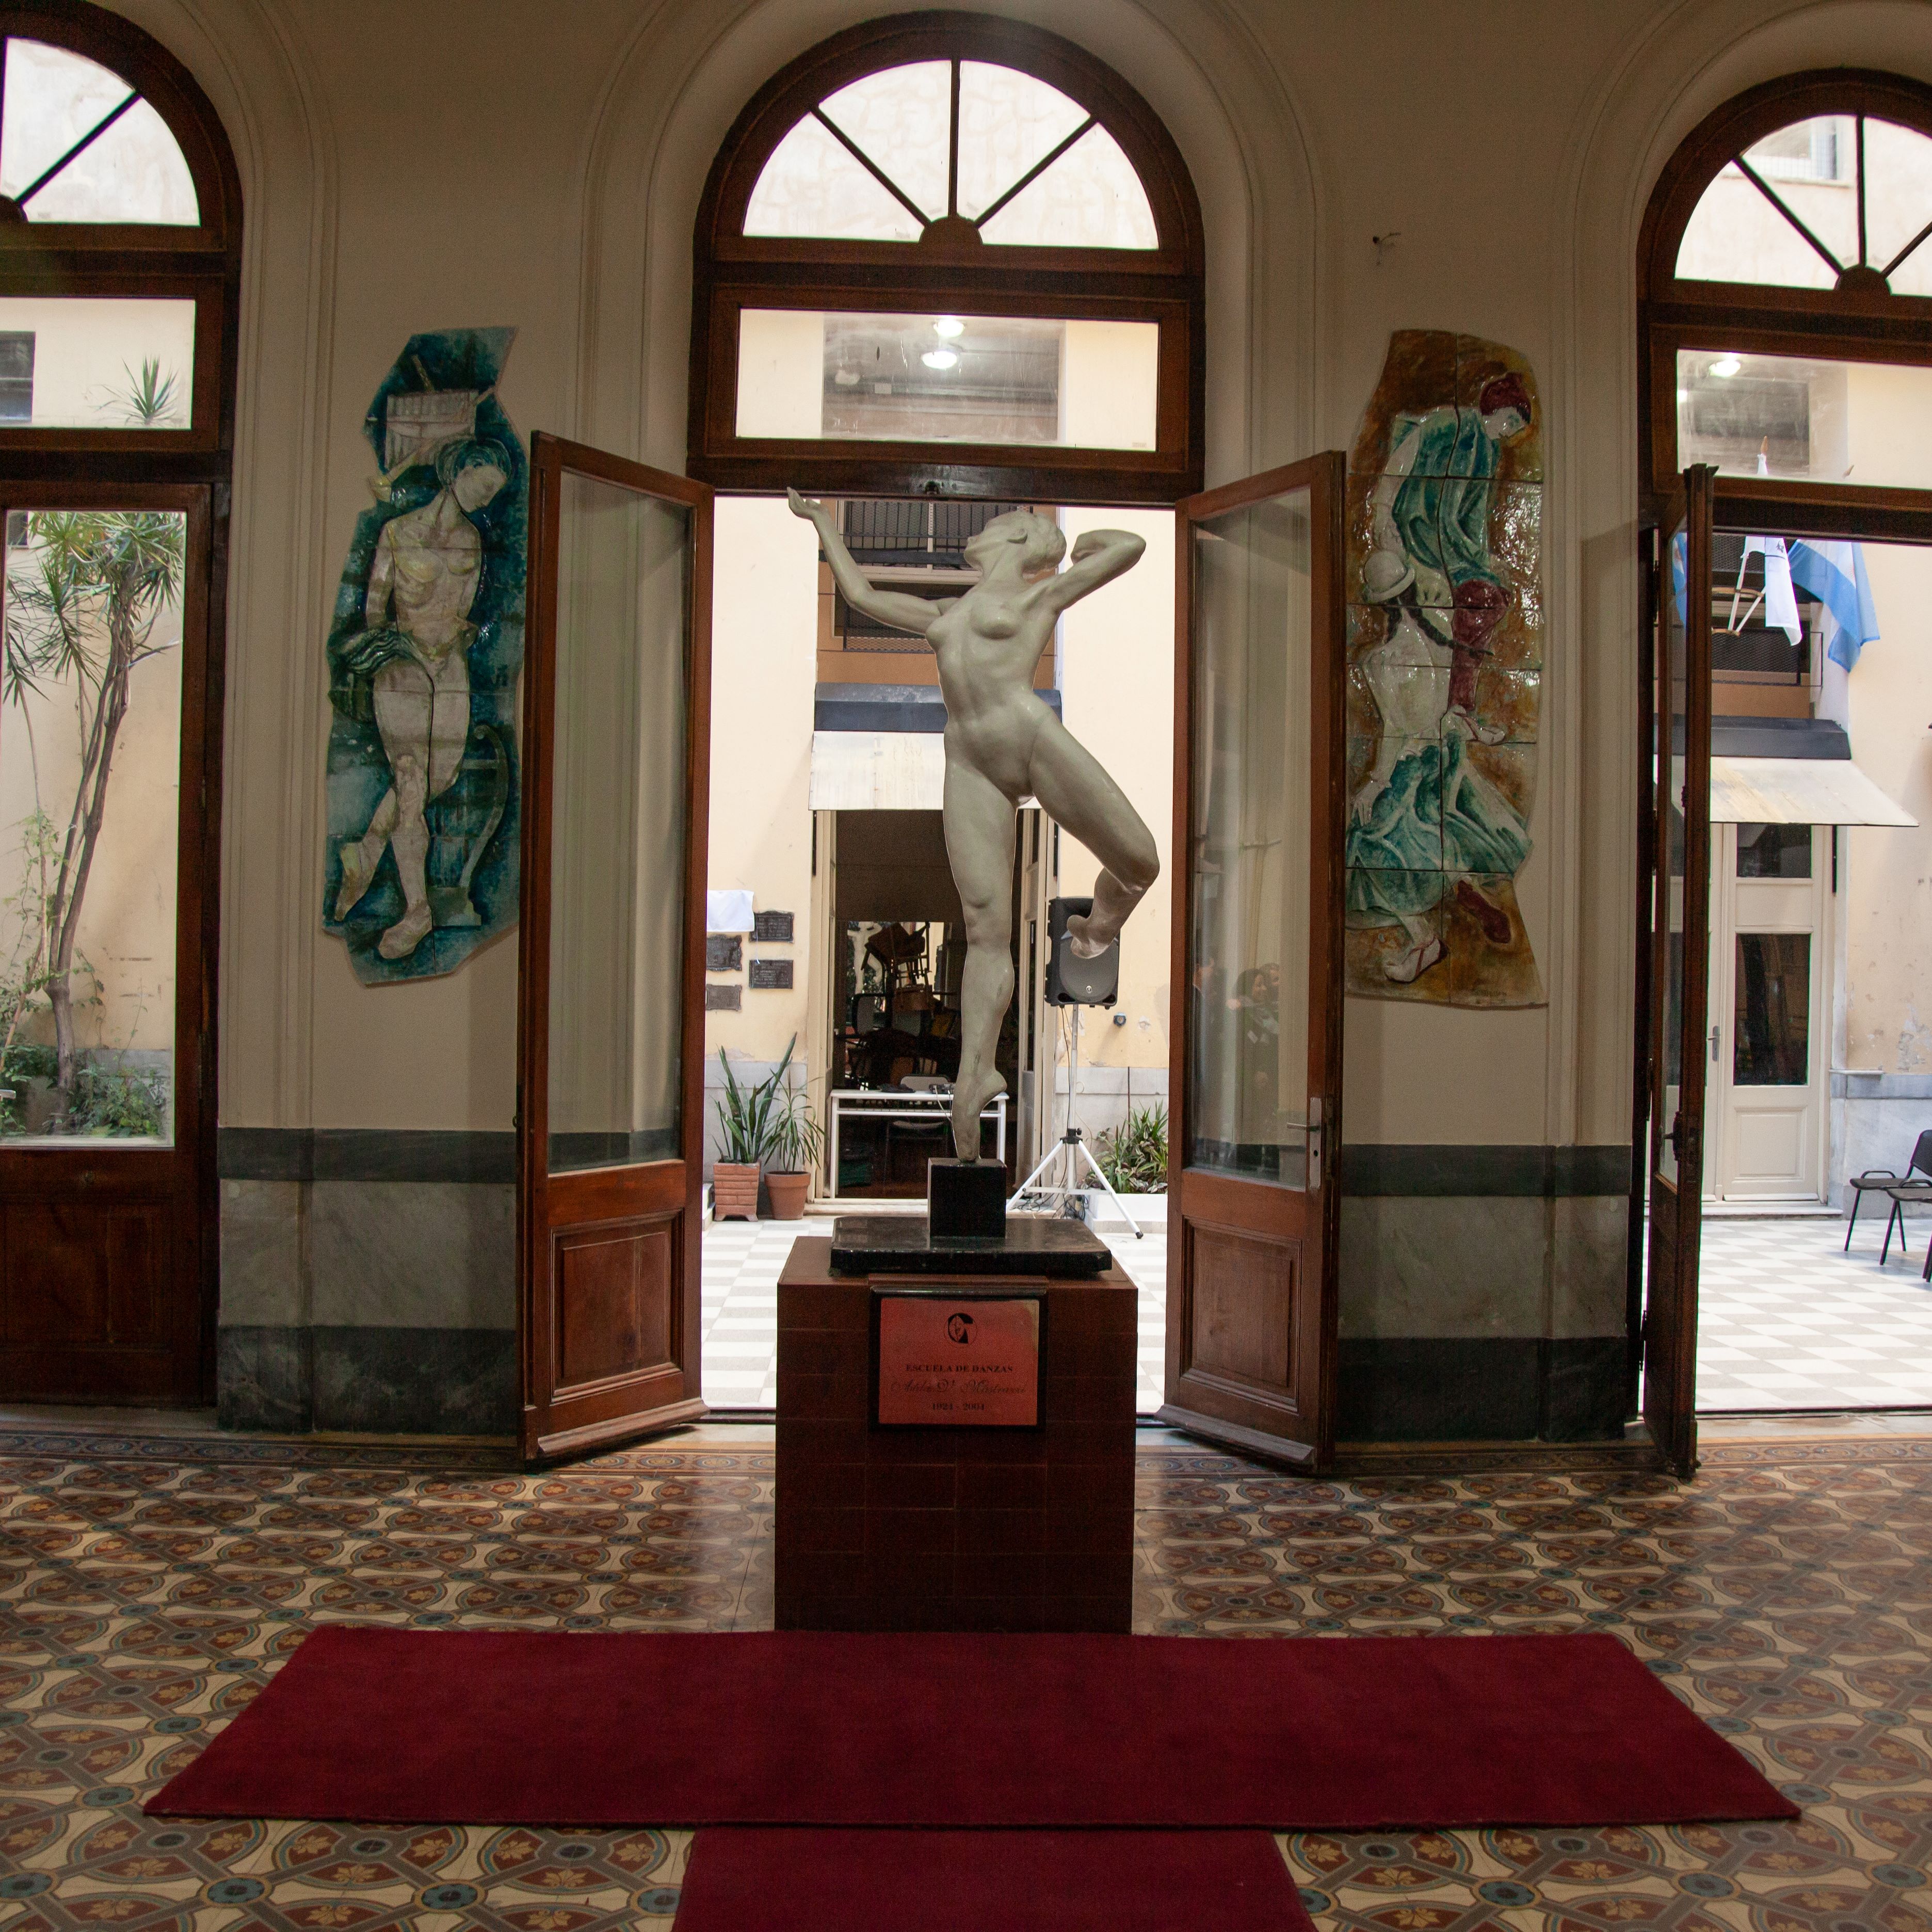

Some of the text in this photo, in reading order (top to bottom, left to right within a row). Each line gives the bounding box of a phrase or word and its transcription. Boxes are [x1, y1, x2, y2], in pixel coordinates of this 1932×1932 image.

[906, 1364, 1013, 1373] ESCUELA DE DANZAS
